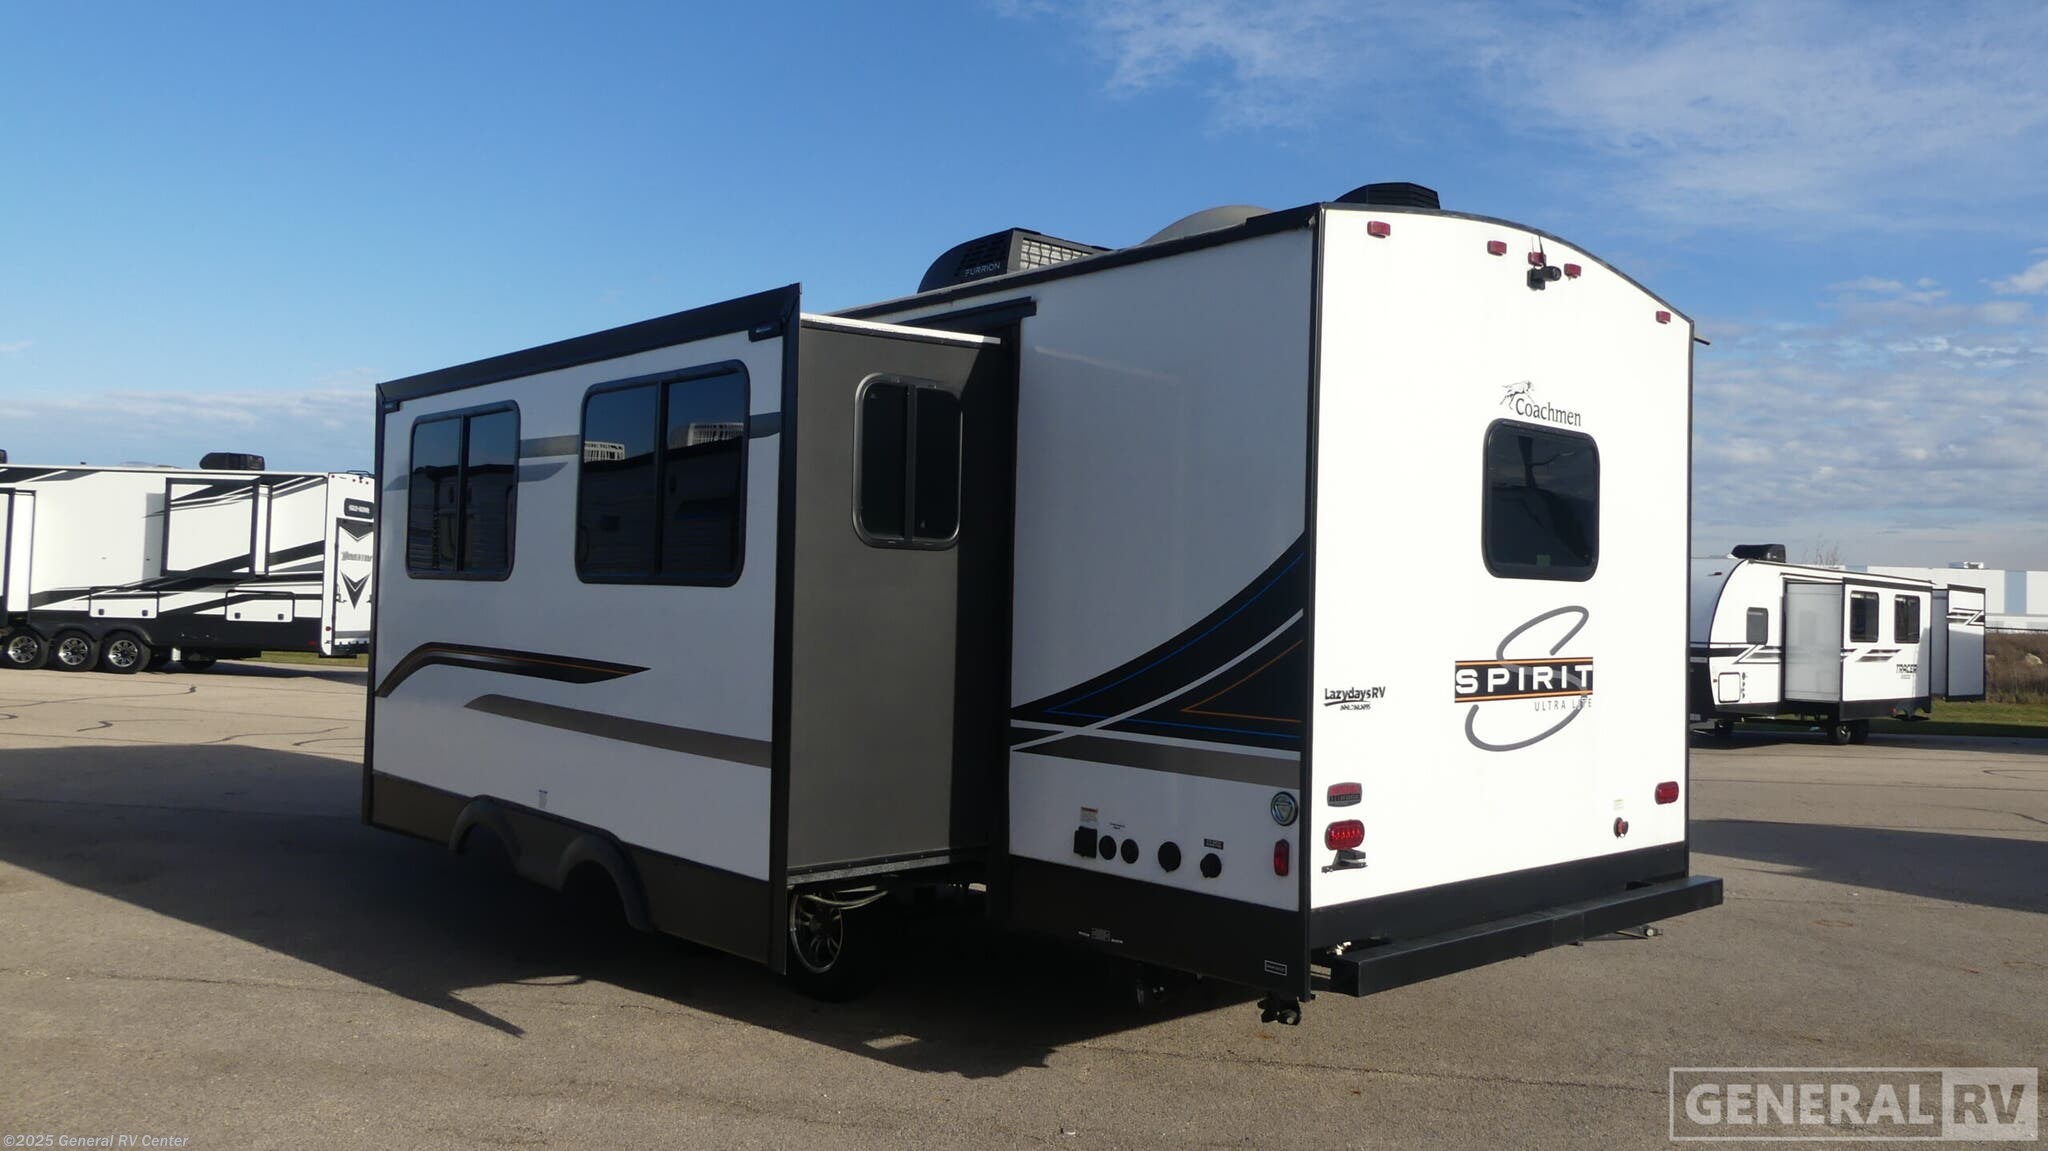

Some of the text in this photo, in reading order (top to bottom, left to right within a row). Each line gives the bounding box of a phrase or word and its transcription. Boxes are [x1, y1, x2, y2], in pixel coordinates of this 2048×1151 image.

[1516, 398, 1582, 427] Coachmen
[1455, 665, 1593, 694] SPIRIT
[1533, 699, 1566, 712] ULTRA
